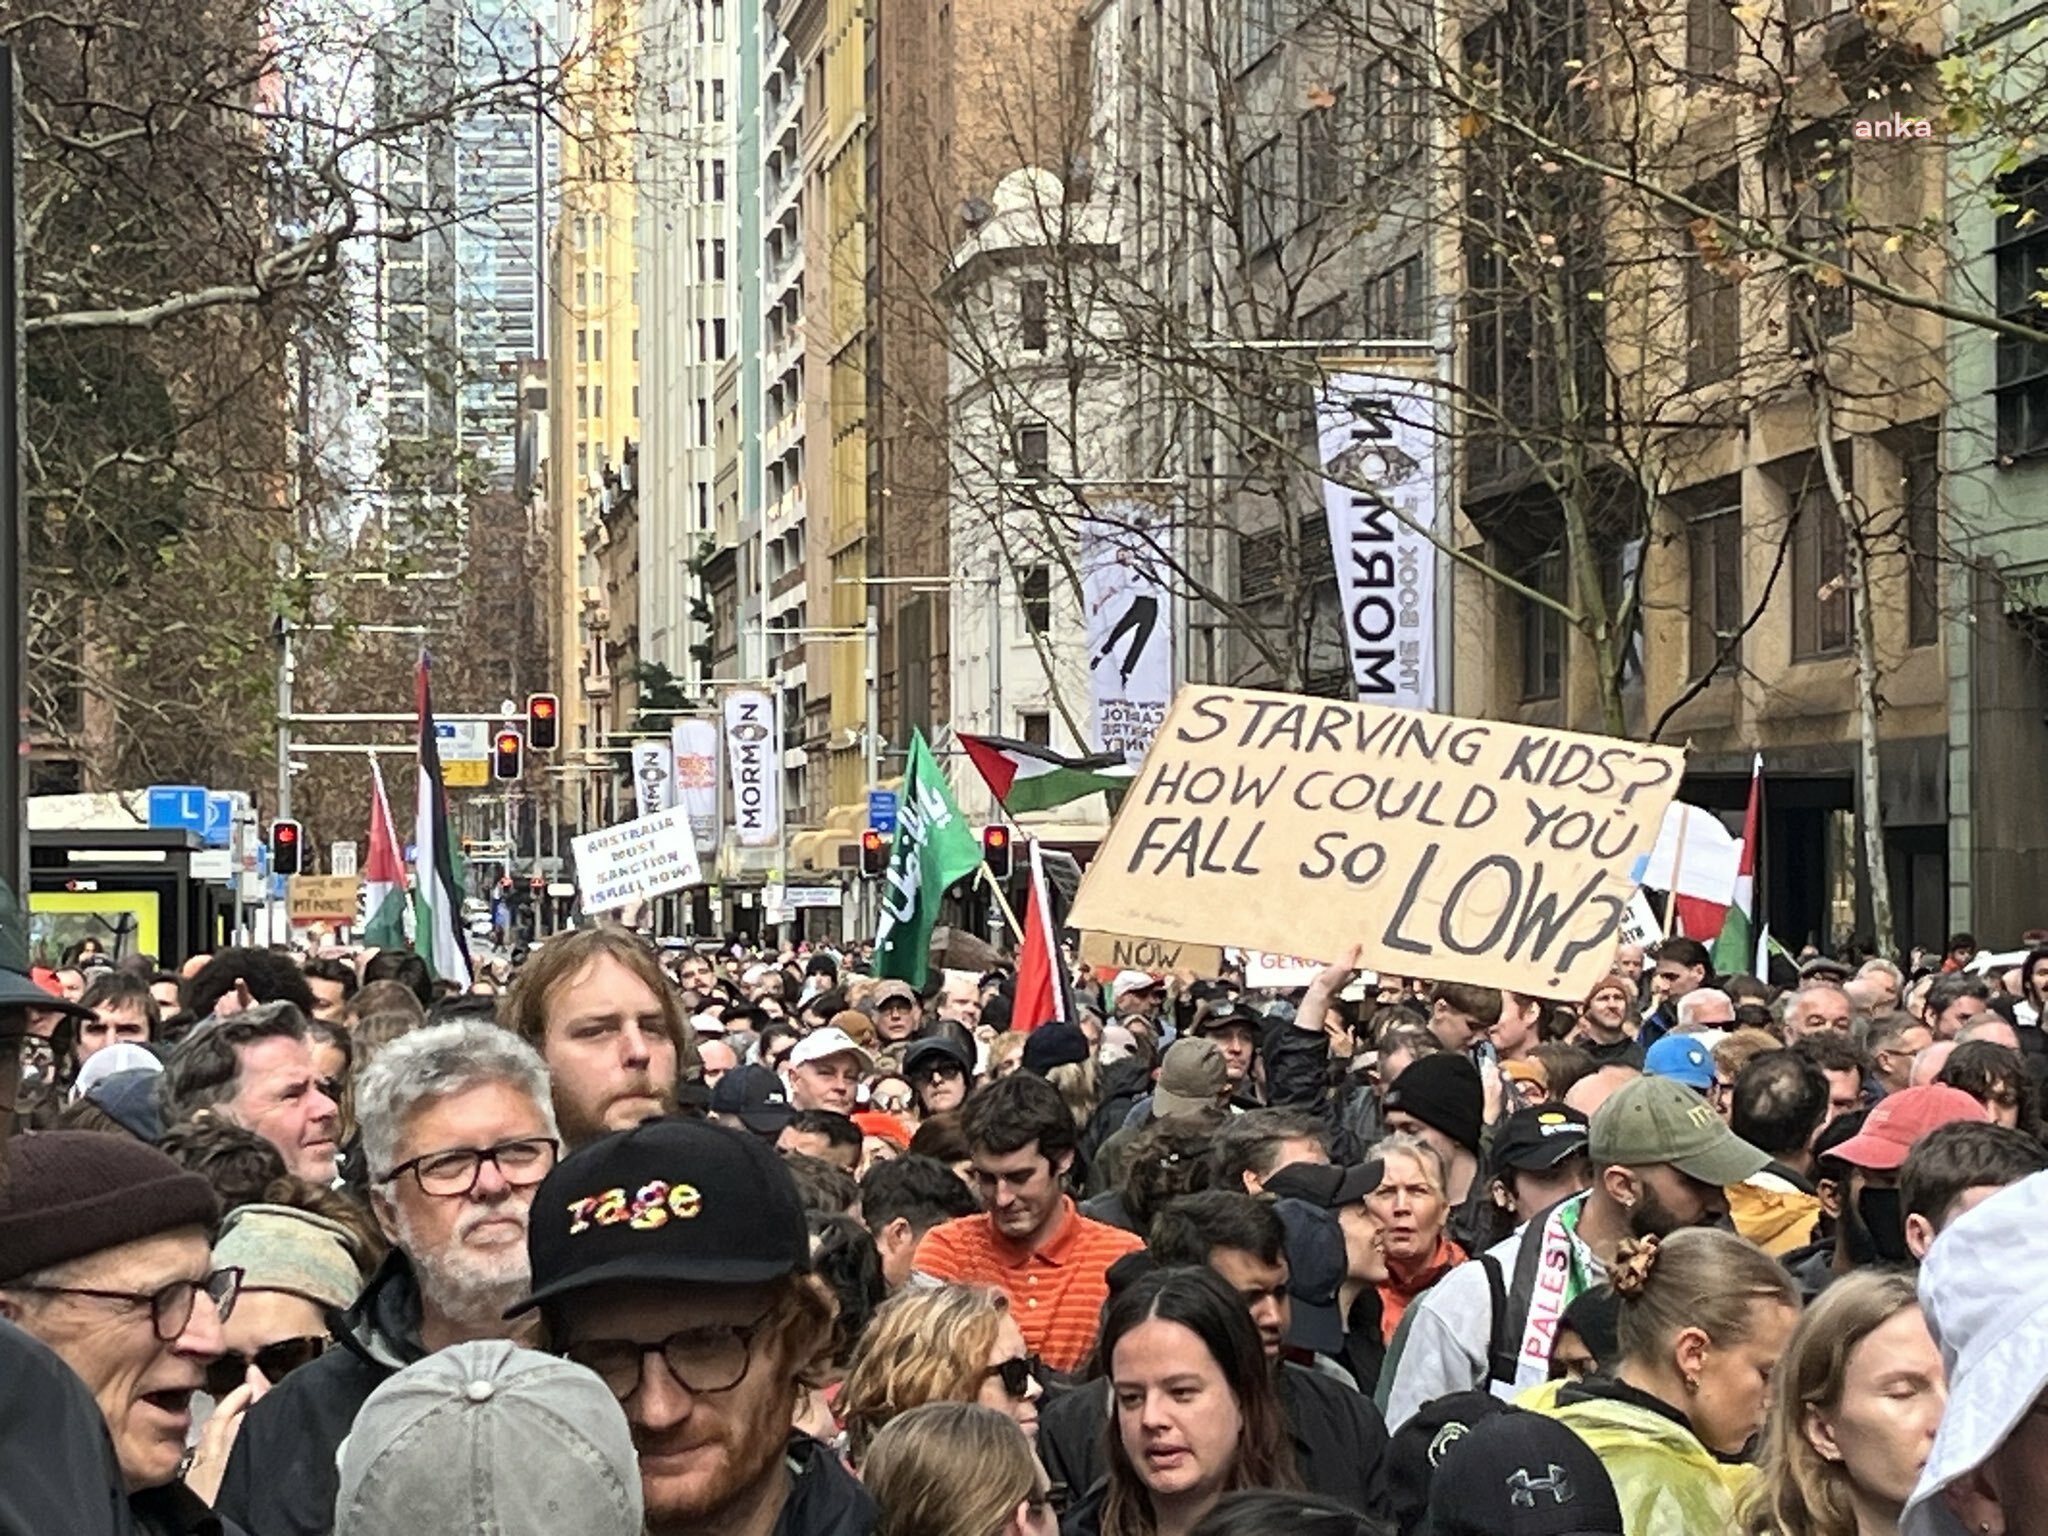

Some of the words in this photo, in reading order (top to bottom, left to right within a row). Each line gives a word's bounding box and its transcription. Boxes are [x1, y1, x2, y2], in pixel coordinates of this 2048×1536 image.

[739, 703, 763, 829] MORMON
[1176, 695, 1490, 767] STARVING
[1502, 734, 1673, 815] KIDS?
[1145, 760, 1287, 807] HOW
[1294, 768, 1498, 829] COULD
[1525, 796, 1639, 859] YOU
[1127, 816, 1262, 876] FALL
[1300, 832, 1387, 884] SO
[1382, 843, 1624, 987] LOW?
[1112, 940, 1182, 969] NOW
[1260, 952, 1322, 969] GENO
[567, 1179, 703, 1234] rage
